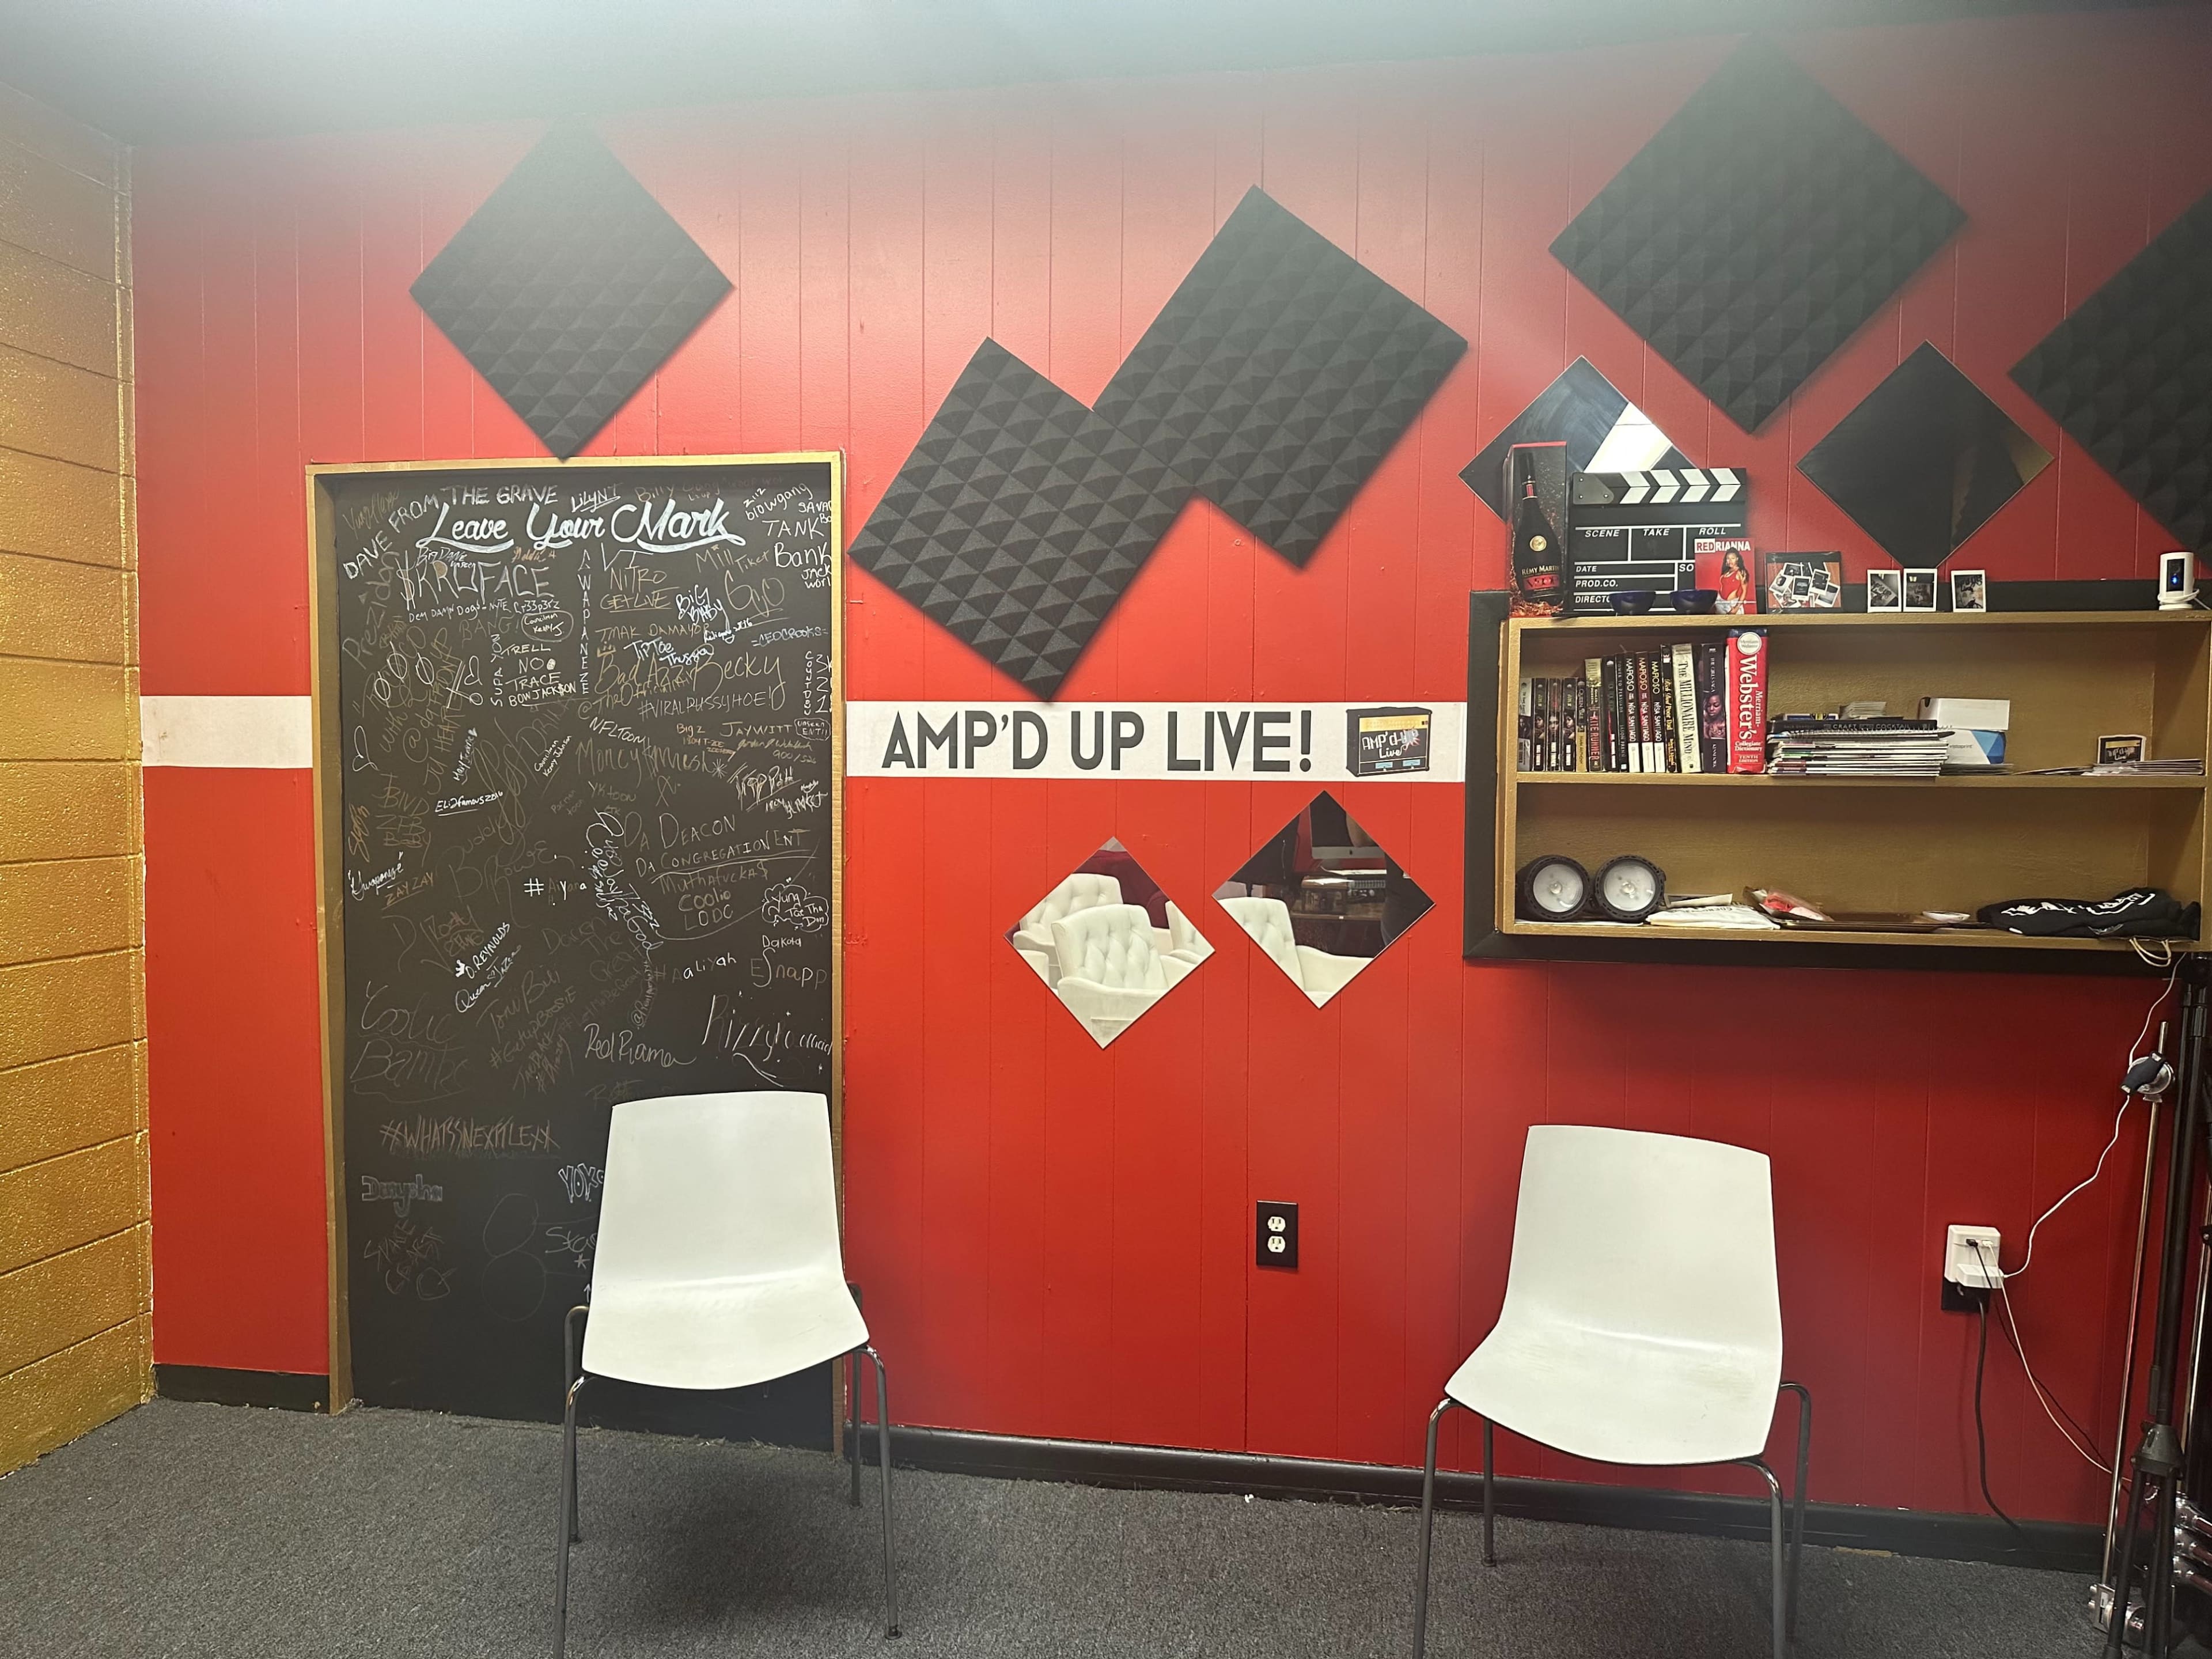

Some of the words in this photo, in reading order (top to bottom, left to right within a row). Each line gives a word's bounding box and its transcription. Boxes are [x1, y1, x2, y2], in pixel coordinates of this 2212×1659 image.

[745, 483, 813, 521] blowgang
[343, 531, 393, 579] DAVE
[388, 493, 440, 533] FROM
[440, 486, 490, 505] THE
[497, 485, 559, 505] GRAVE
[416, 503, 514, 554] Leave
[527, 503, 606, 550] Your
[611, 498, 746, 553] Mark
[762, 518, 824, 540] TANK
[1585, 528, 1620, 538] SCENE
[1643, 528, 1670, 537] TAKE
[1699, 527, 1726, 536] ROLL
[774, 542, 832, 568] Bank
[1575, 579, 1619, 588] PROD.CO.
[524, 612, 558, 626] Councilman
[502, 643, 551, 656] TRELL
[505, 672, 561, 691] TRACE
[1679, 679, 1695, 732] MILLIONAIRE
[1738, 654, 1758, 740] Webster's
[1755, 690, 1763, 728] Merriam-
[676, 723, 694, 737] Big
[719, 721, 793, 738] JAYWITT
[1590, 716, 1600, 731] KITE
[1628, 715, 1637, 742] SANTIAGO
[1641, 715, 1649, 742] SANTIAGO
[1654, 715, 1662, 742] SANTIAGO
[881, 710, 1048, 770] AMP'D
[1071, 711, 1144, 771] UP
[1167, 710, 1312, 772] LIVE!
[1378, 746, 1404, 759] Live
[1589, 733, 1600, 760] RUNNER
[659, 813, 736, 849] DEACON
[660, 830, 770, 870] CONGREGATION
[774, 828, 811, 847] ENT
[762, 935, 802, 948] Dakota
